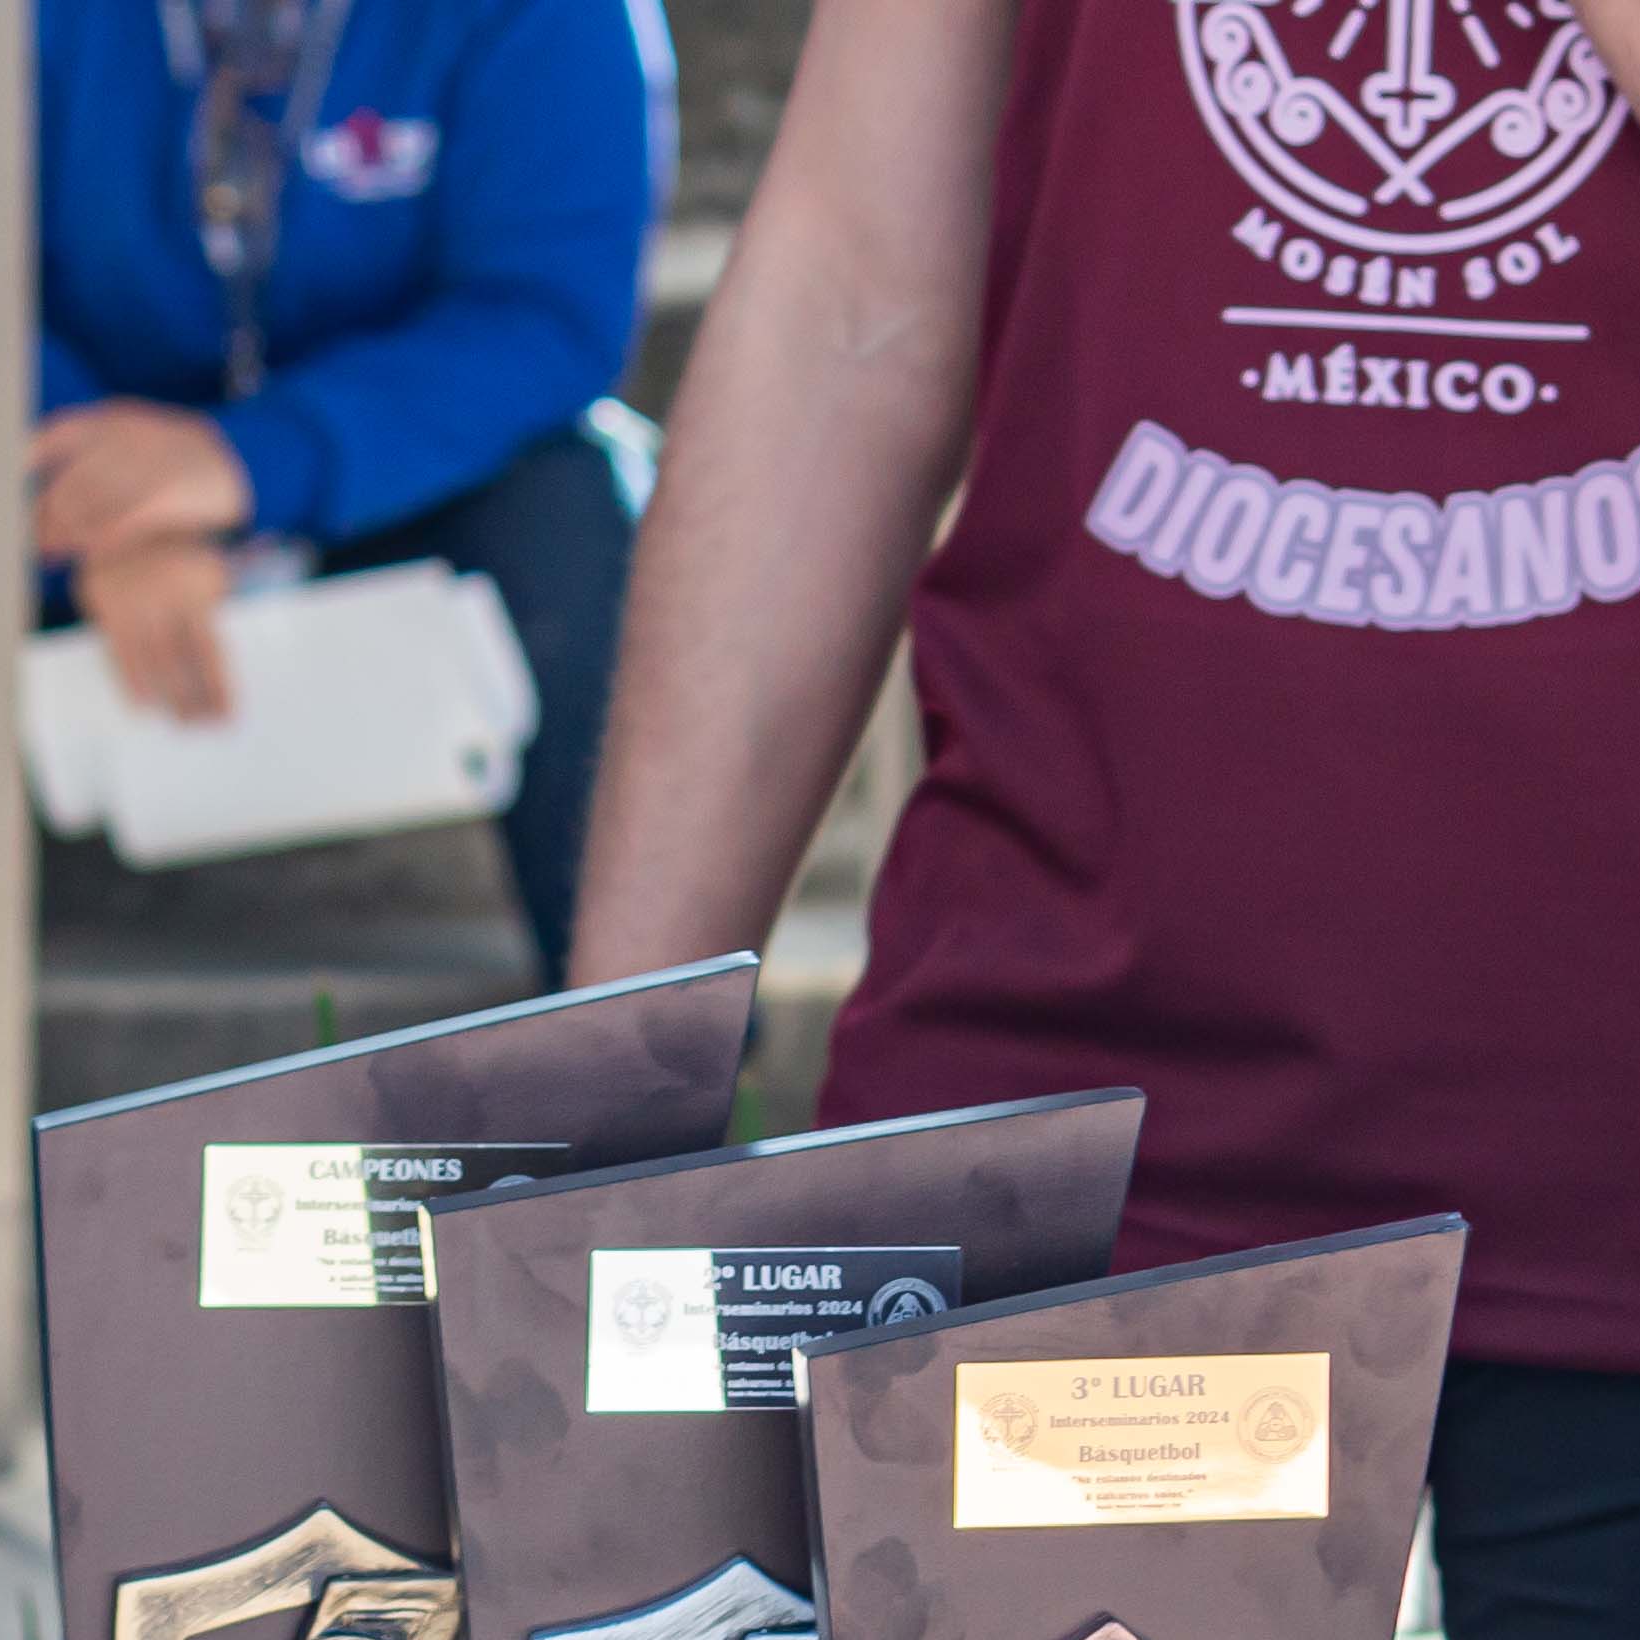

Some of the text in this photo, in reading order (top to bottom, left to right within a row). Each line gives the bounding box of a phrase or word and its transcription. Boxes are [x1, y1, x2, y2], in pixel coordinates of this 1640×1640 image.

[1463, 222, 1580, 299] SOL
[308, 1158, 463, 1182] CAMPEONES
[743, 1264, 843, 1291] LUGAR
[816, 1299, 863, 1316] 2024
[1112, 1374, 1206, 1399] LUGAR
[1049, 1411, 1230, 1429] Interseminarios 2024
[1078, 1443, 1201, 1465] Básquetbol
